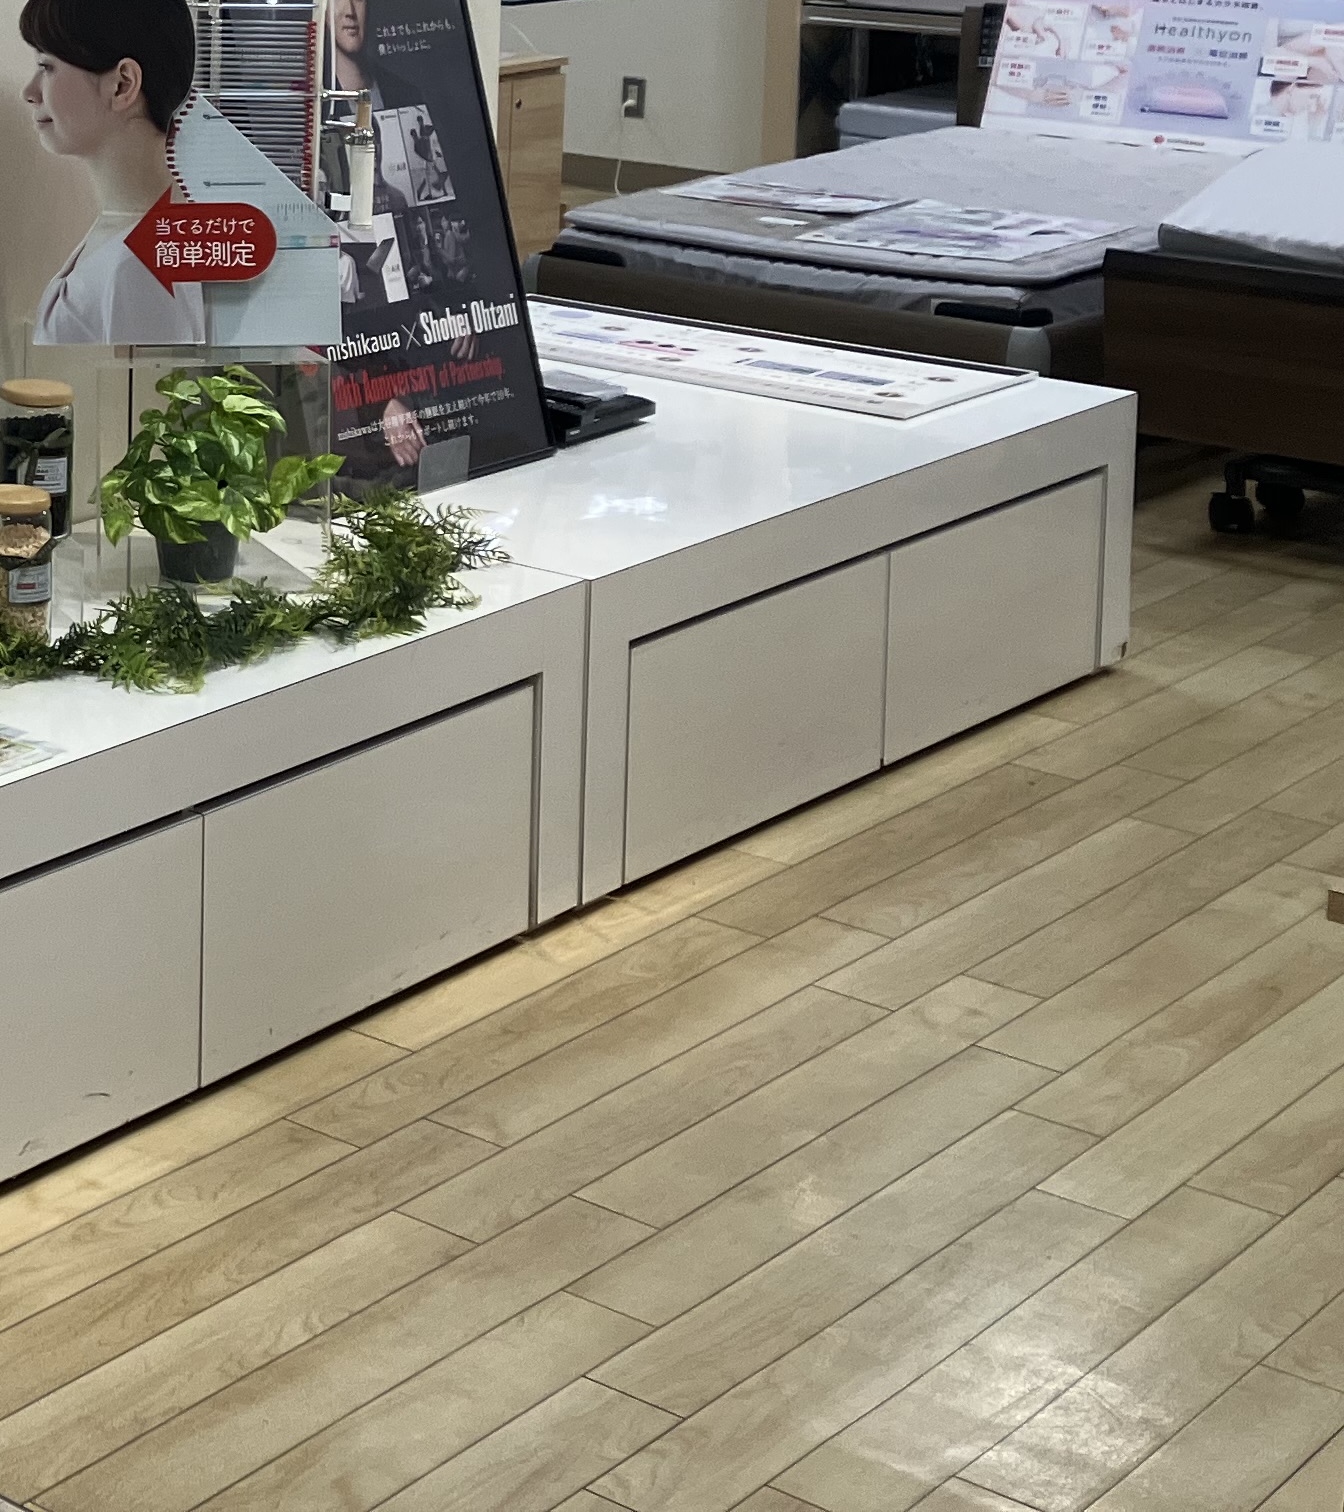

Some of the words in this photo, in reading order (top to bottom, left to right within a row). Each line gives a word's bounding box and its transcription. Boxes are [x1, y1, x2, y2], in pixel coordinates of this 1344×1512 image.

[155, 217, 256, 236] 当てるだけで
[155, 240, 257, 268] 簡単測定
[326, 330, 401, 362] nishikawa
[419, 303, 470, 346] Shohei
[470, 293, 520, 334] Ohtani
[362, 363, 438, 405] Anniversary
